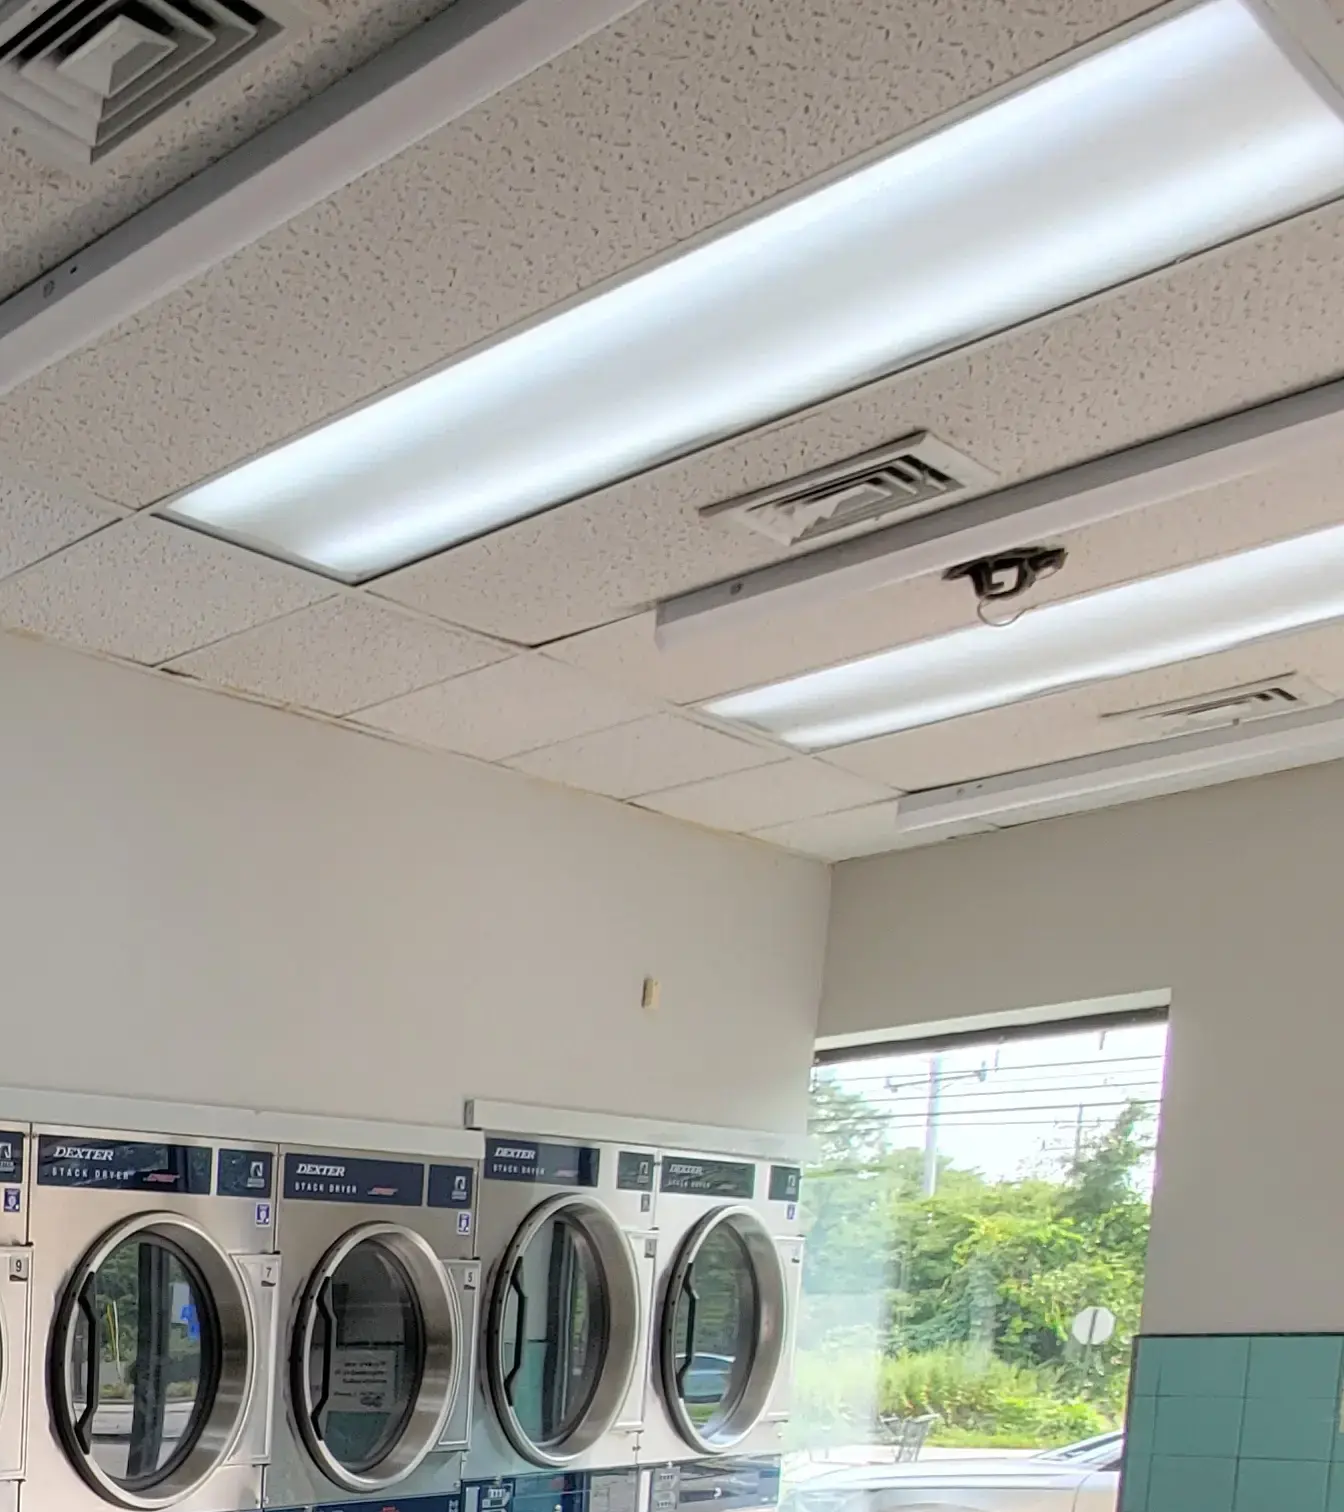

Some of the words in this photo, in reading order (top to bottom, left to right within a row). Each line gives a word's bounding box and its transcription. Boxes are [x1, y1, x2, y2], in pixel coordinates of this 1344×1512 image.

[52, 1146, 114, 1162] DEXTER
[495, 1147, 537, 1160] DEXTER
[51, 1166, 89, 1179] STACK
[94, 1169, 130, 1181] DRYER
[296, 1163, 346, 1178] DEXTER
[15, 1259, 23, 1273] 9
[265, 1267, 273, 1278] 7
